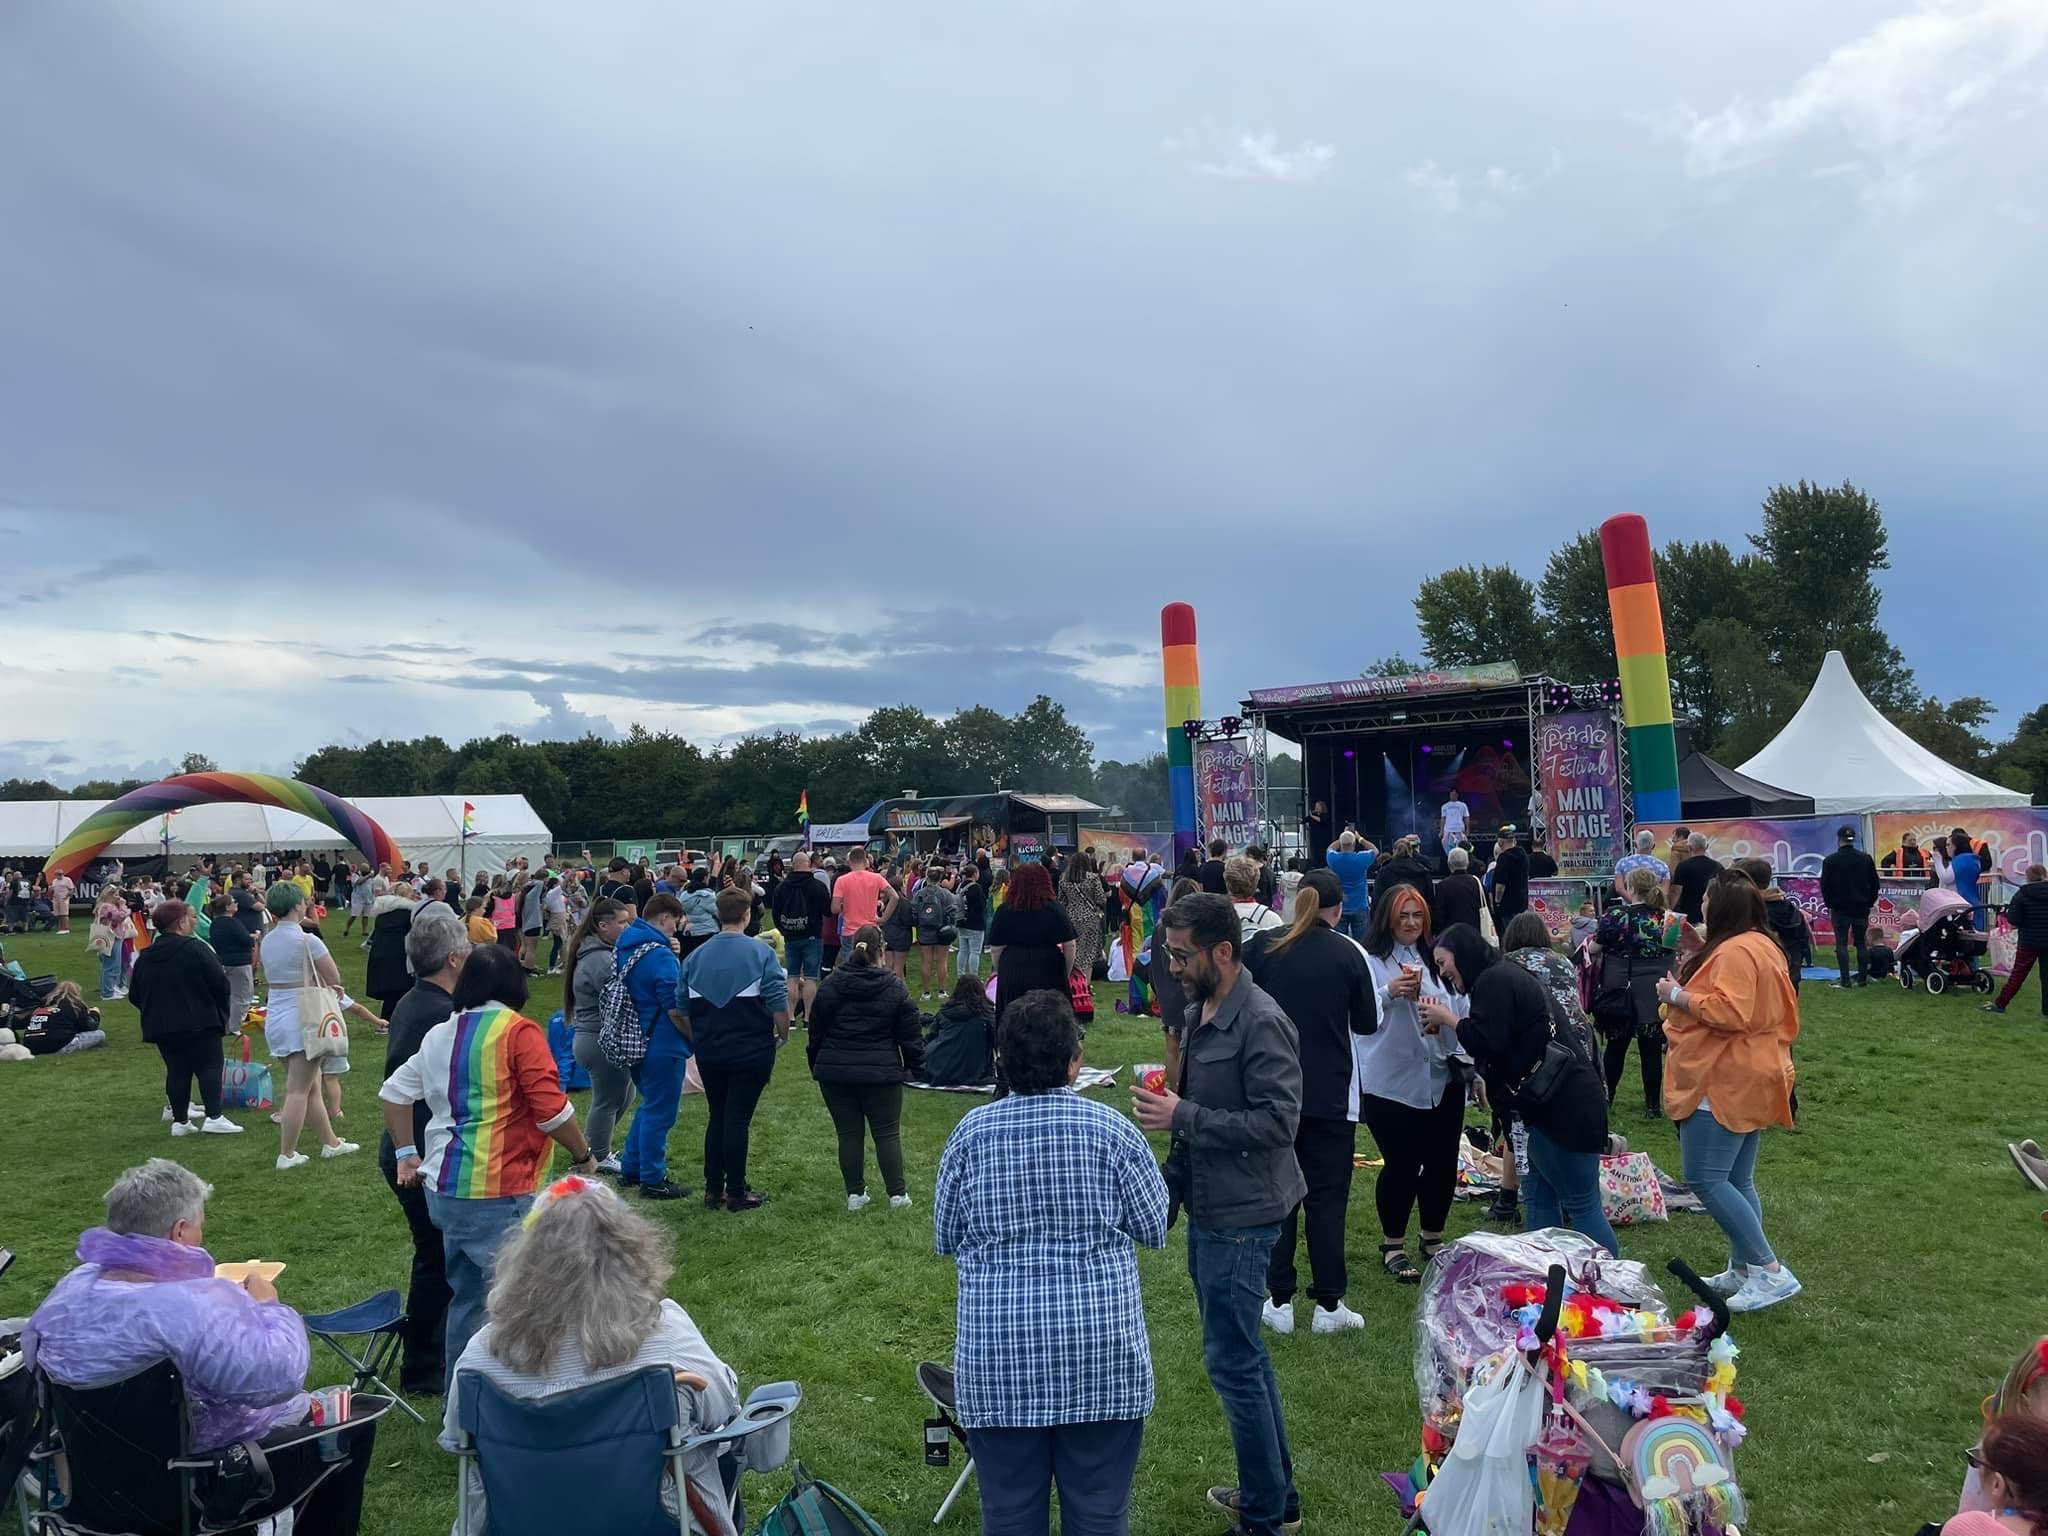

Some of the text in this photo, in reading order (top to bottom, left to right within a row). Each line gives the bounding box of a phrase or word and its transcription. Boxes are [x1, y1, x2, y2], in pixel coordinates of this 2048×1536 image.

[1340, 683, 1371, 698] MAIN
[1372, 679, 1408, 695] STAGE
[1544, 725, 1607, 753] Pride
[1201, 751, 1245, 773] Pride
[1546, 750, 1608, 779] Festival
[1204, 772, 1246, 795] Festival
[1557, 787, 1604, 812] MAIN
[897, 812, 938, 827] INDIAN
[1212, 801, 1244, 822] MAIN
[1212, 824, 1251, 844] STAGE
[1557, 814, 1612, 839] STAGE
[1887, 888, 1918, 896] SUPPORTED
[1610, 1168, 1643, 1183] ANYTHING
[1613, 1197, 1643, 1218] POSSIBLE
